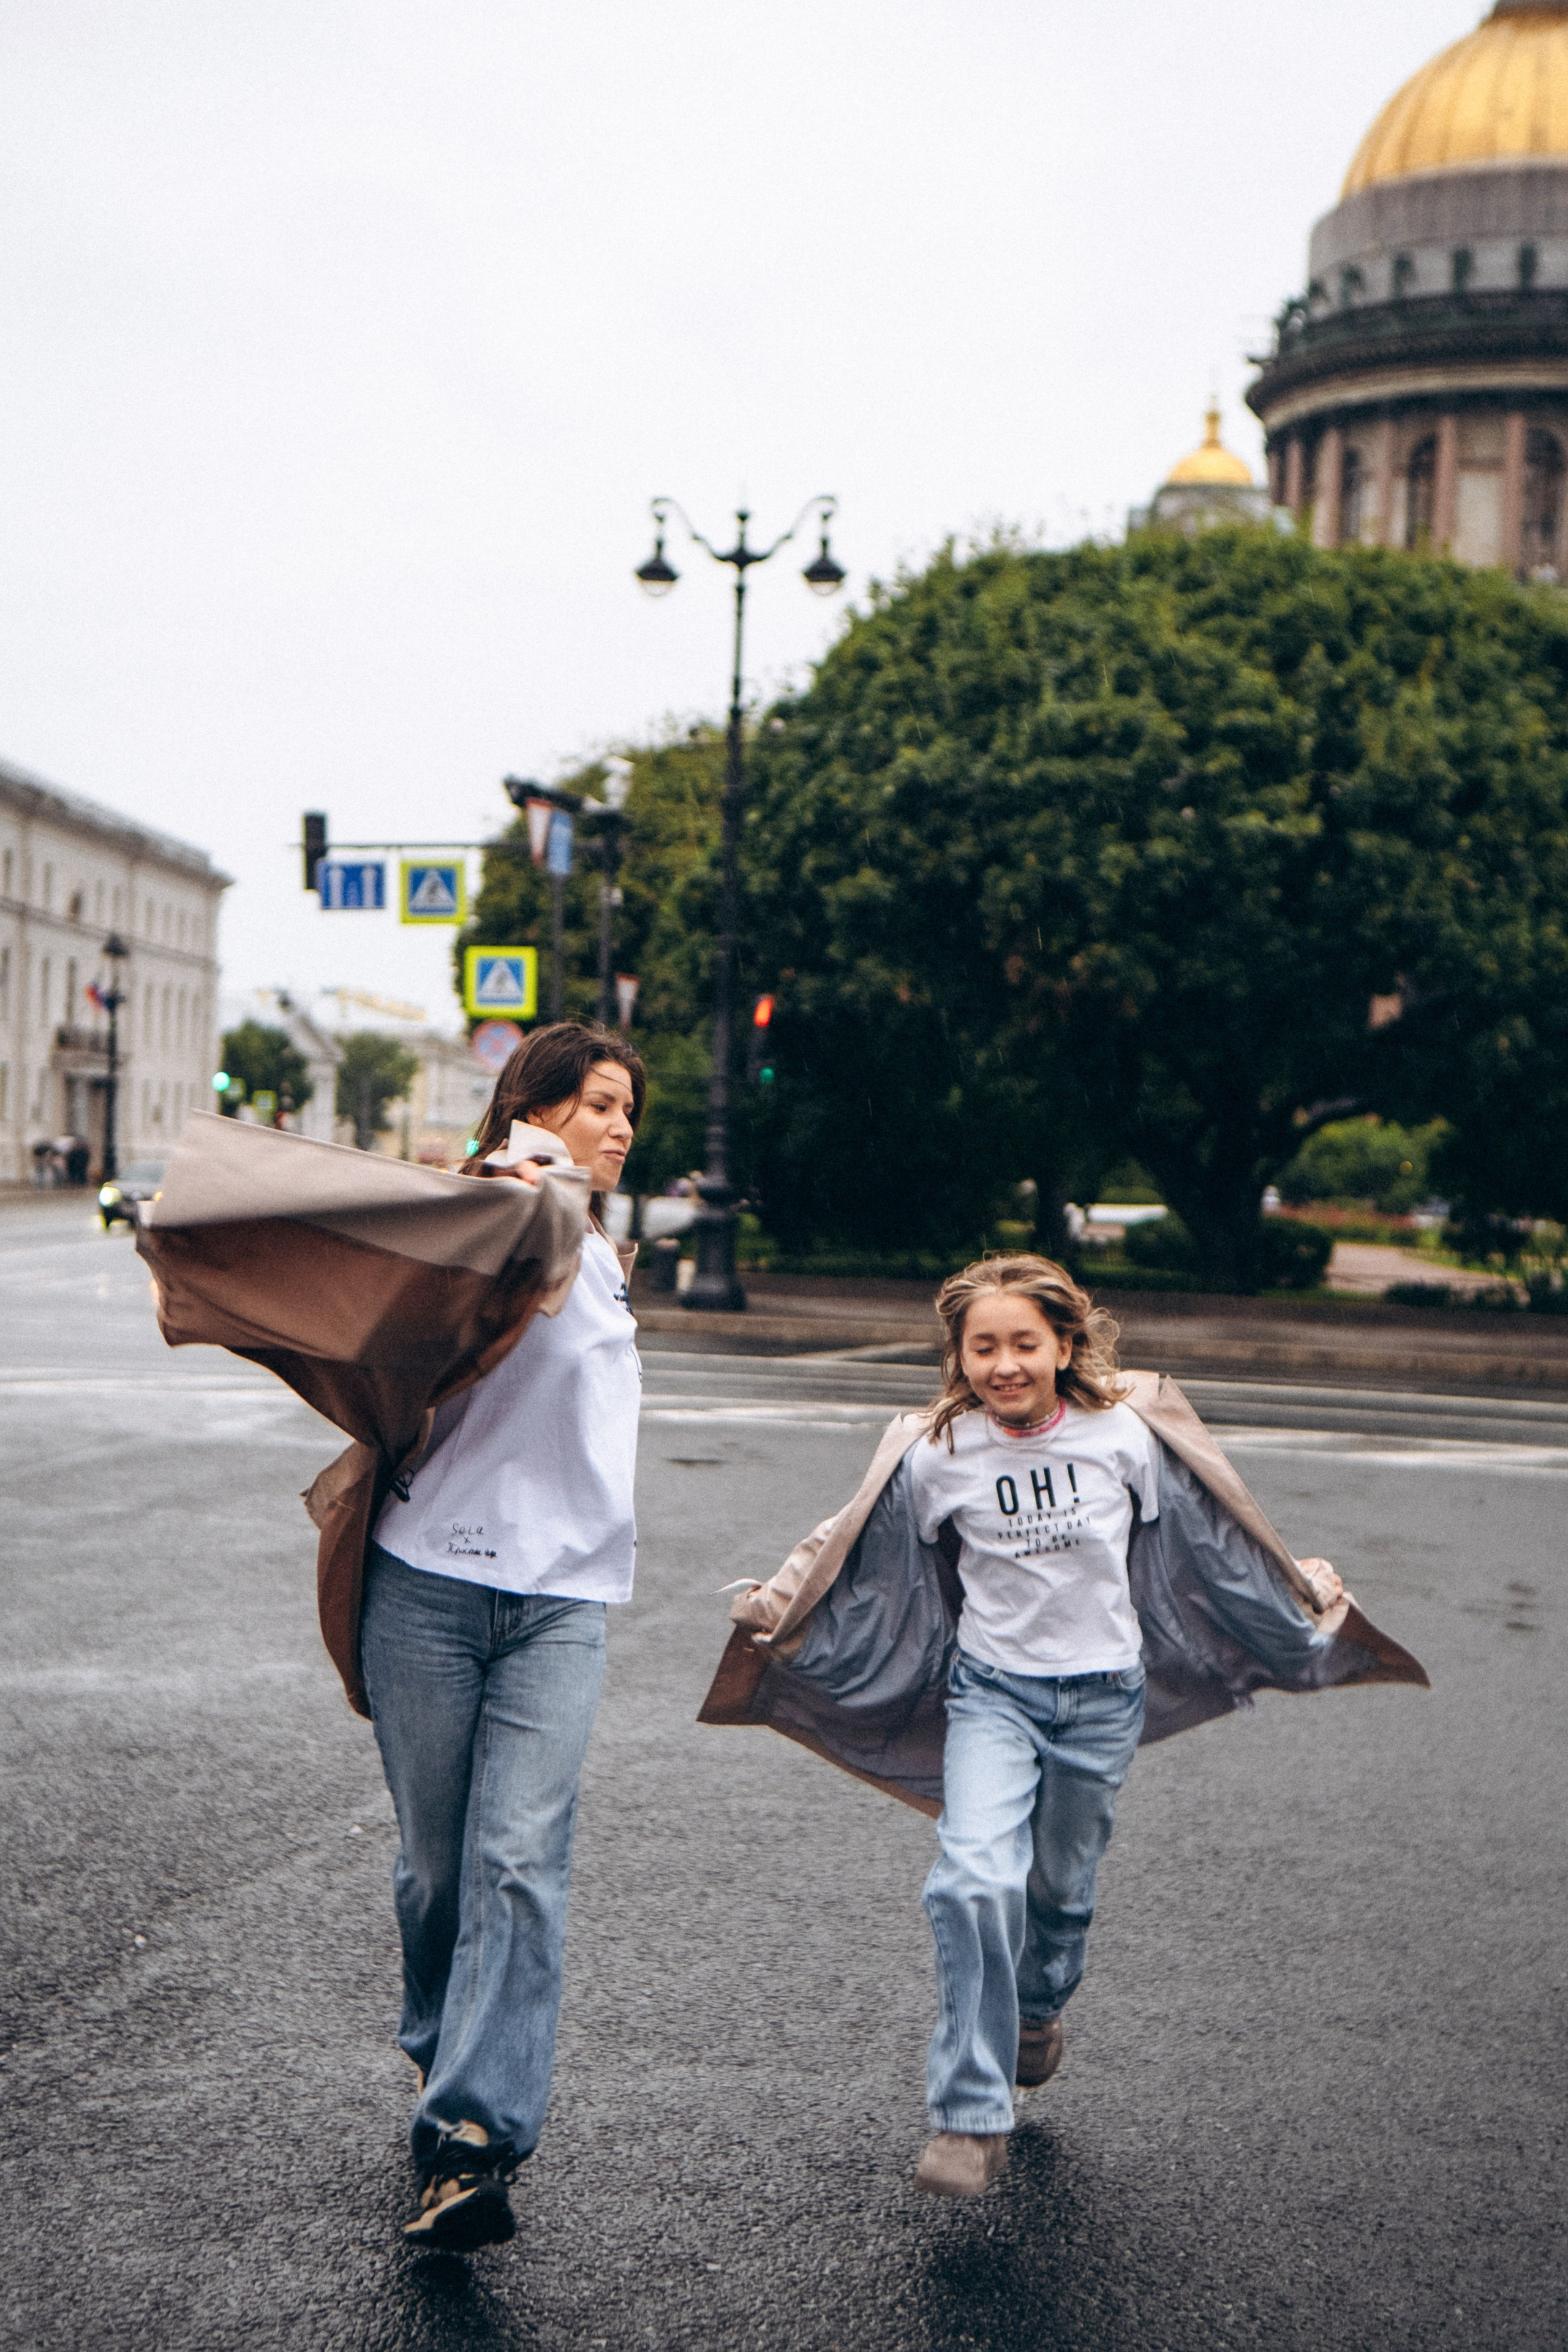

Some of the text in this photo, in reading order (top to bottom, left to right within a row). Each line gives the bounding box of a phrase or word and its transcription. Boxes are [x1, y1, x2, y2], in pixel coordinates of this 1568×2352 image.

[996, 1463, 1080, 1515] OH!
[1009, 1507, 1076, 1527] TODAY IS
[1066, 1516, 1090, 1529] DAY
[1027, 1538, 1041, 1547] TO
